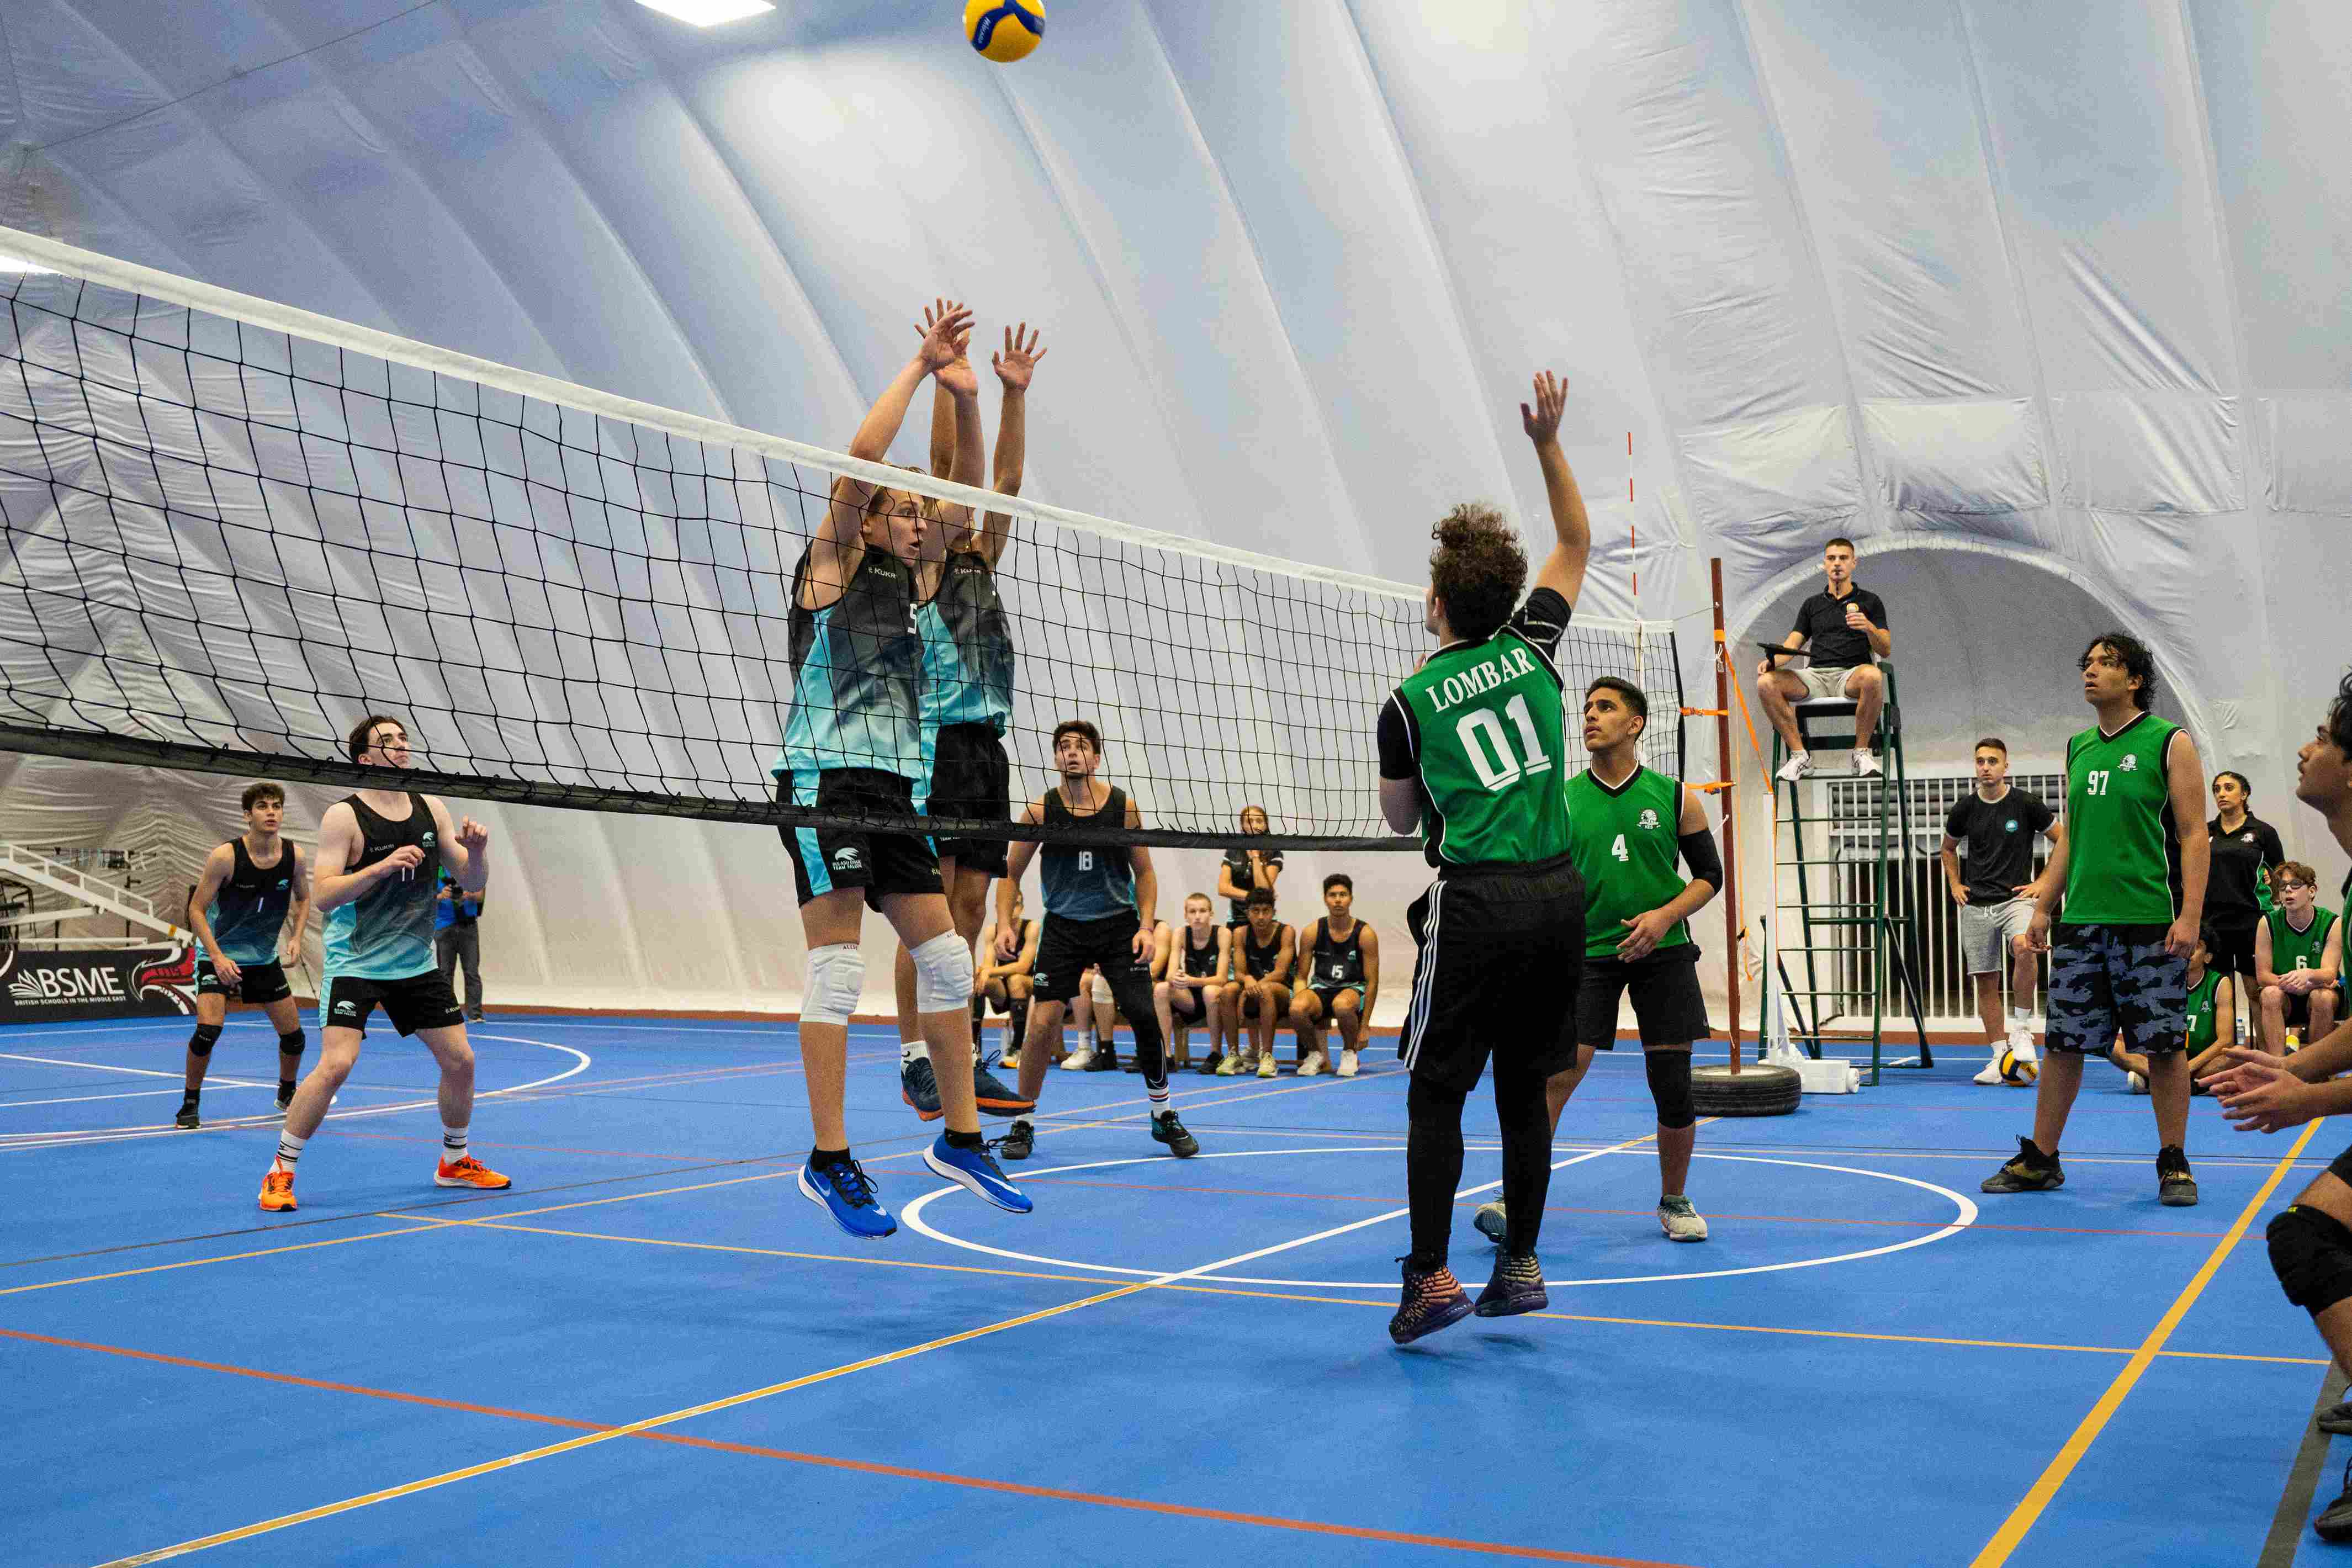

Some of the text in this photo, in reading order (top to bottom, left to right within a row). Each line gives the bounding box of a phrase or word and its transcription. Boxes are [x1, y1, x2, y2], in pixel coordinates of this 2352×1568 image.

[1426, 648, 1535, 713] LOMBAR
[1456, 693, 1551, 792] 01
[2088, 771, 2109, 795] 97
[1612, 834, 1629, 861] 4
[1078, 851, 1093, 871] 18
[1332, 965, 1343, 979] 15
[2296, 956, 2307, 972] 6
[36, 967, 125, 997] BSME
